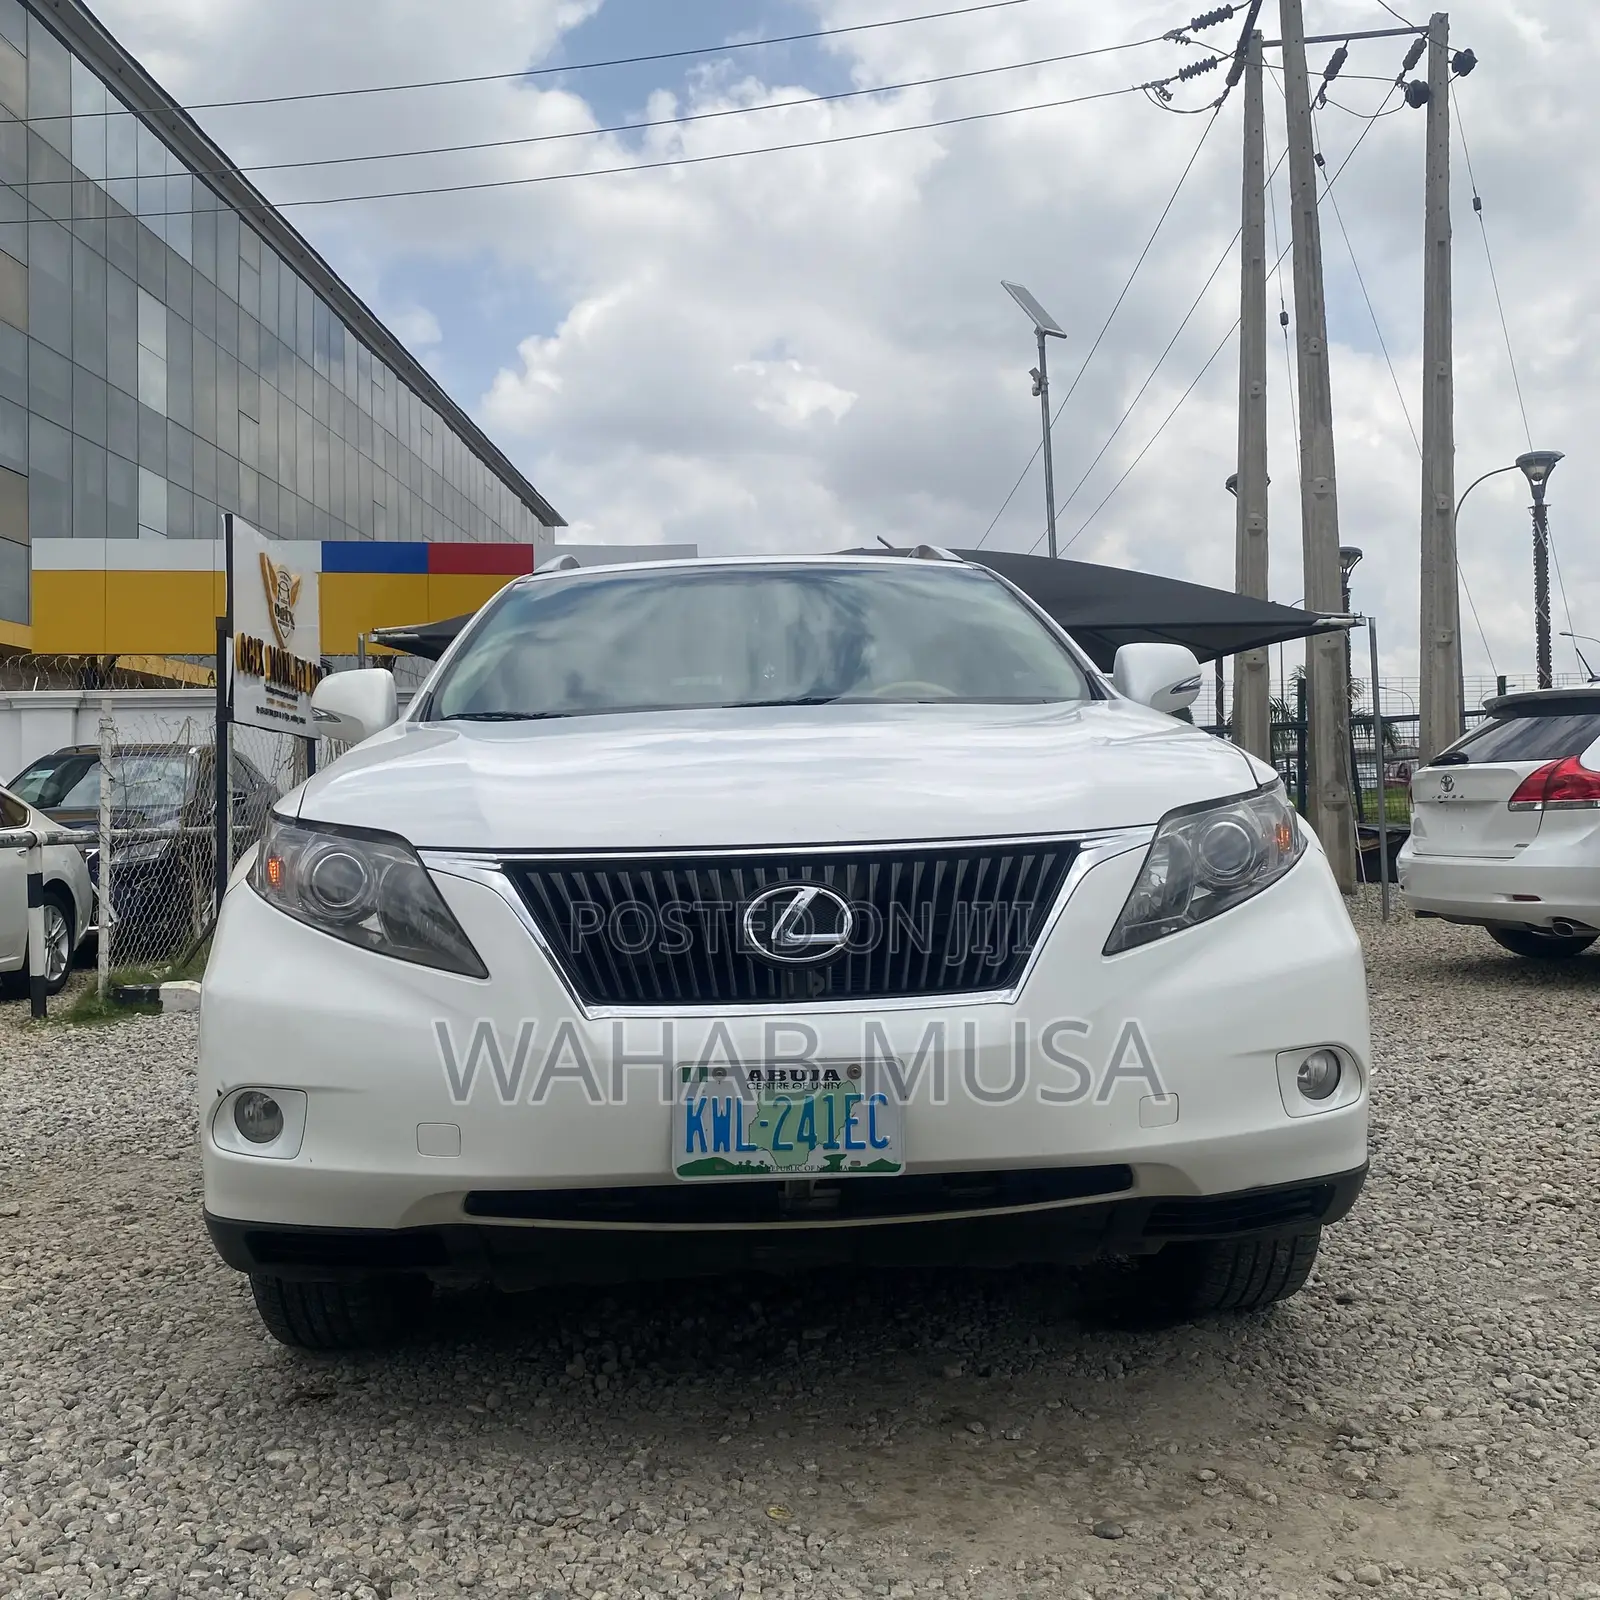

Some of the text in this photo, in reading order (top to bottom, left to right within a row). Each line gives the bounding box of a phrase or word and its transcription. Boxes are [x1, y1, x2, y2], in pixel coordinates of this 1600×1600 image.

[235, 631, 264, 677] OGIX
[746, 1069, 841, 1081] ABUJA
[747, 1082, 789, 1090] CENTRE
[811, 1081, 841, 1090] UNITY
[686, 1092, 891, 1153] KWL-241EC
